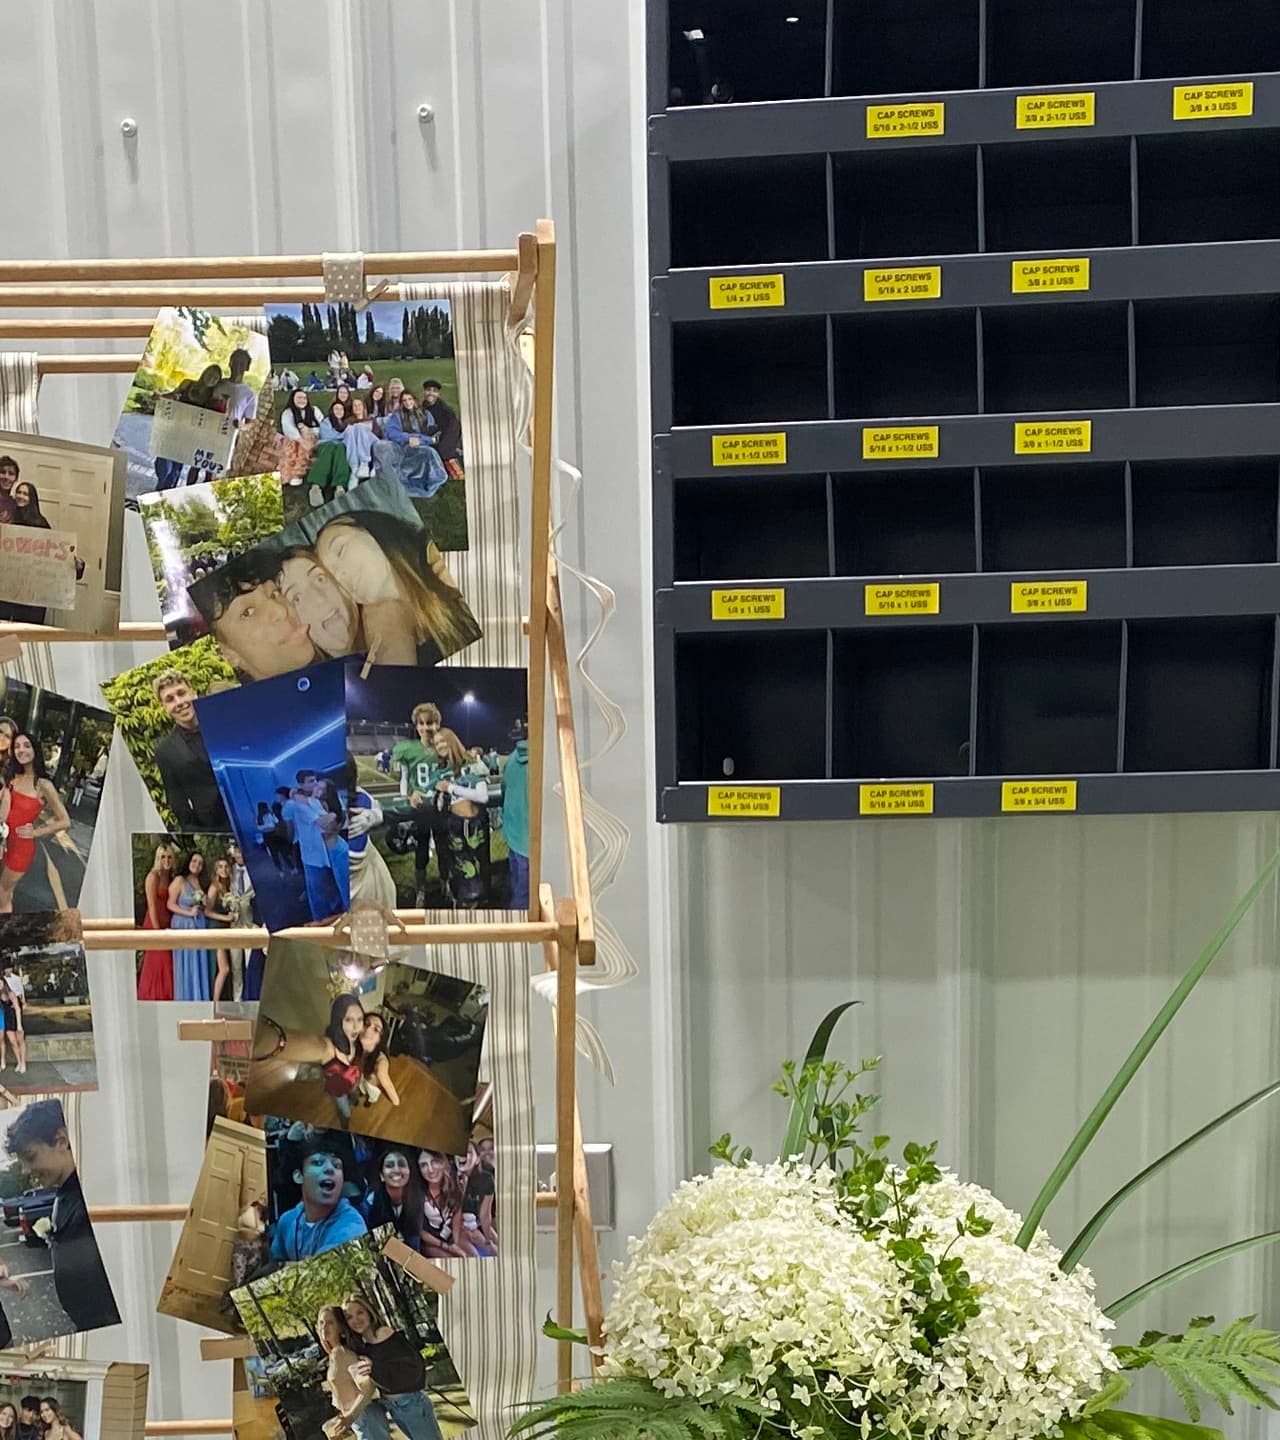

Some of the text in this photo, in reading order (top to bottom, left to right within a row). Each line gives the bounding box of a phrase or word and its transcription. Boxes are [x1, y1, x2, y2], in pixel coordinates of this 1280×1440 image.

[1183, 88, 1244, 101] CAP SCREWS
[1026, 99, 1086, 111] CAP SCREWS
[1218, 101, 1238, 111] USS
[876, 108, 935, 120] CAP SCREWS
[1046, 112, 1067, 122] 2-1/2
[1068, 111, 1087, 121] USS
[873, 123, 891, 132] 5/16
[899, 121, 919, 131] 2-1/2
[920, 120, 939, 130] USS
[1021, 264, 1081, 276] CAP SCREWS
[874, 272, 932, 284] CAP SCREWS
[1056, 276, 1075, 286] USS
[719, 280, 776, 292] CAP SCREWS
[877, 286, 896, 295] 5/16
[910, 284, 929, 294] USS
[726, 294, 738, 303] 1/4
[752, 292, 771, 302] USS
[872, 432, 930, 442] CAP SCREWS
[1024, 426, 1083, 437] CAP SCREWS
[721, 438, 778, 449] CAP SCREWS
[869, 444, 887, 454] 5/16
[895, 443, 914, 452] 1-1/2
[915, 443, 934, 452] USS
[1044, 439, 1064, 448] 1-1/2
[1065, 438, 1084, 448] USS
[721, 452, 733, 461] 1/4
[741, 451, 761, 460] 1-1/2
[761, 450, 780, 459] USS
[875, 589, 932, 599] CAP SCREWS
[1020, 586, 1078, 597] CAP SCREWS
[721, 594, 776, 604] CAP SCREWS
[878, 600, 896, 610] 5/16
[910, 599, 928, 609] USS
[1054, 597, 1073, 607] USS
[727, 606, 739, 614] 1/4
[753, 605, 771, 614] USS
[869, 789, 925, 799] CAP SCREWS
[1011, 785, 1068, 795] CAP SCREWS
[717, 791, 772, 801] CAP SCREWS
[1047, 797, 1066, 806] USS
[752, 802, 770, 811] USS
[907, 799, 925, 808] USS
